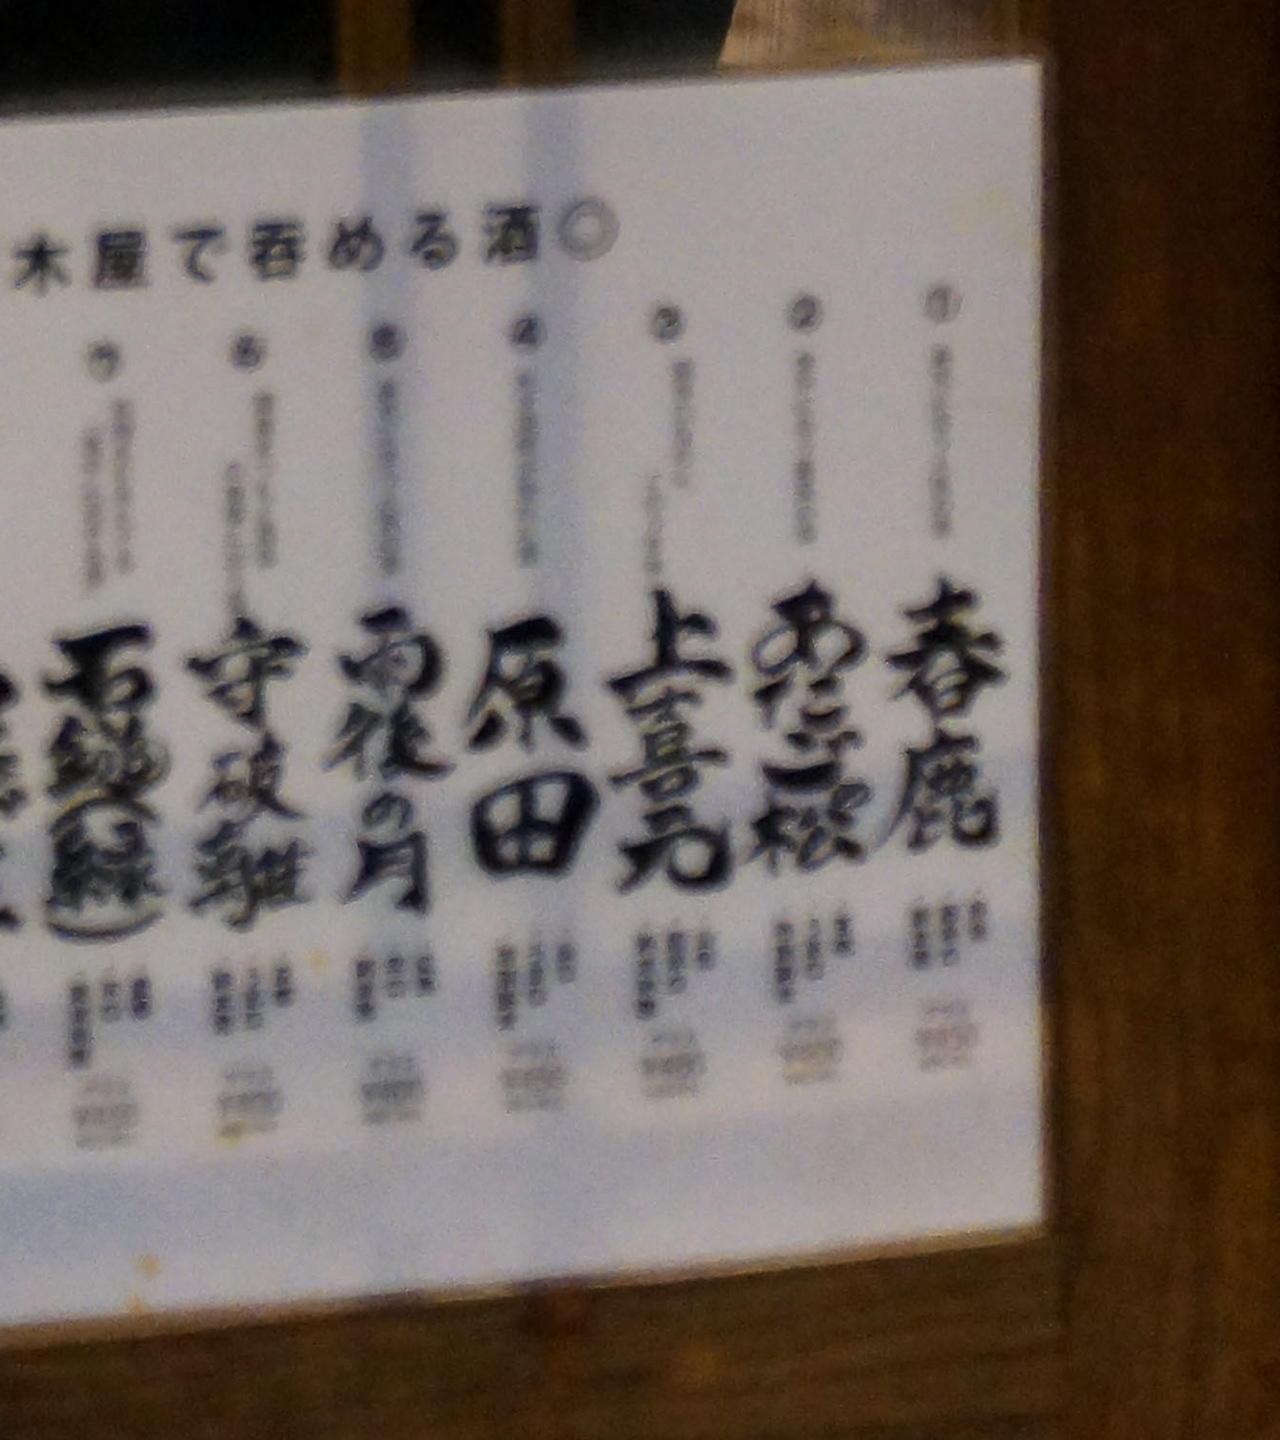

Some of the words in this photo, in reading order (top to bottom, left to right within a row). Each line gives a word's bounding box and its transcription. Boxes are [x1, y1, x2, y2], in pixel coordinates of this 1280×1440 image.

[184, 610, 312, 932] 守破離
[316, 604, 454, 918] 雨後の月
[464, 610, 600, 882] 原田
[604, 584, 735, 896] 上喜元
[880, 573, 1008, 852] 春鹿
